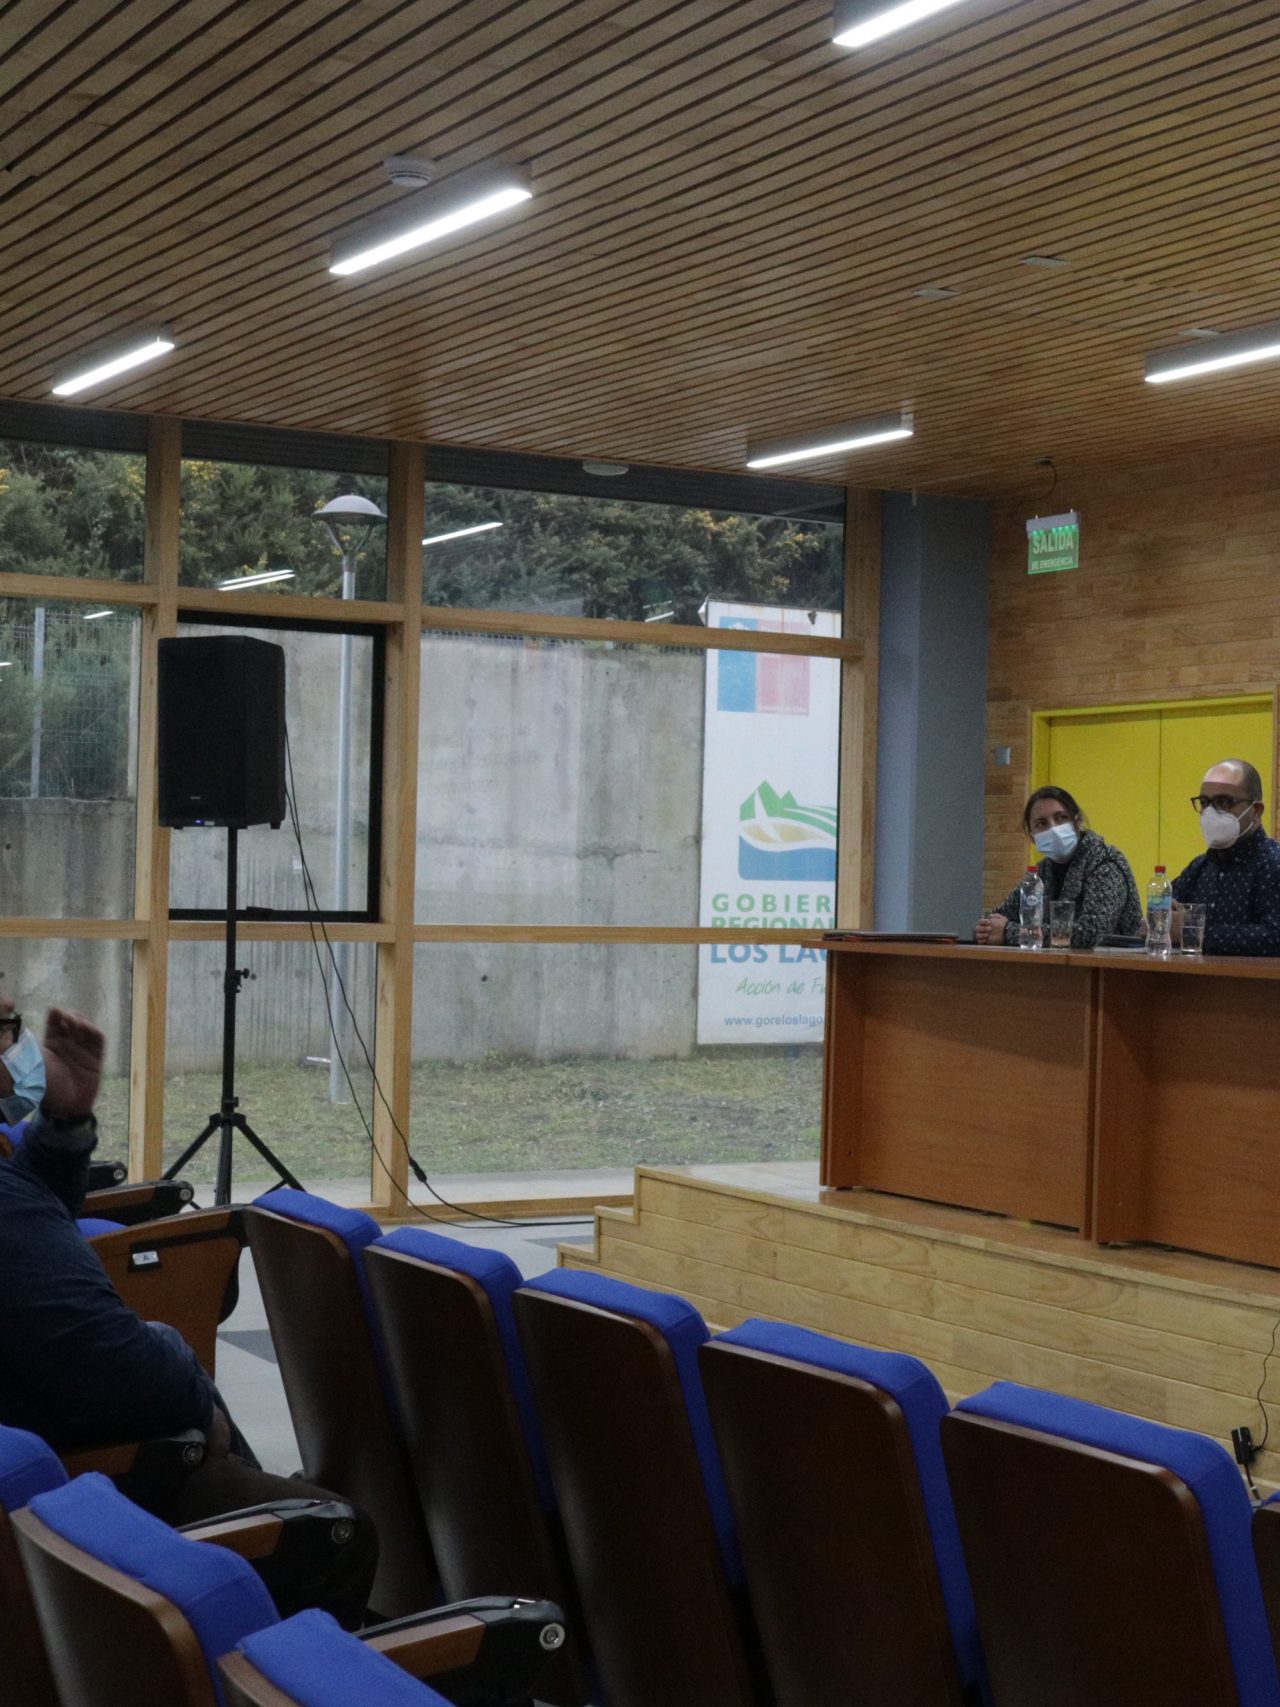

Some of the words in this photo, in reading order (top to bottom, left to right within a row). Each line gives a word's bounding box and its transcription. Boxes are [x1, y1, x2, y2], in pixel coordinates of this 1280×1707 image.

[1033, 531, 1074, 555] SALIDA
[711, 893, 832, 913] GOBIER
[710, 943, 769, 964] LOS
[778, 943, 828, 964] LA
[735, 976, 781, 996] Acción
[786, 980, 805, 994] de
[724, 1013, 824, 1028] www.goreloslago
